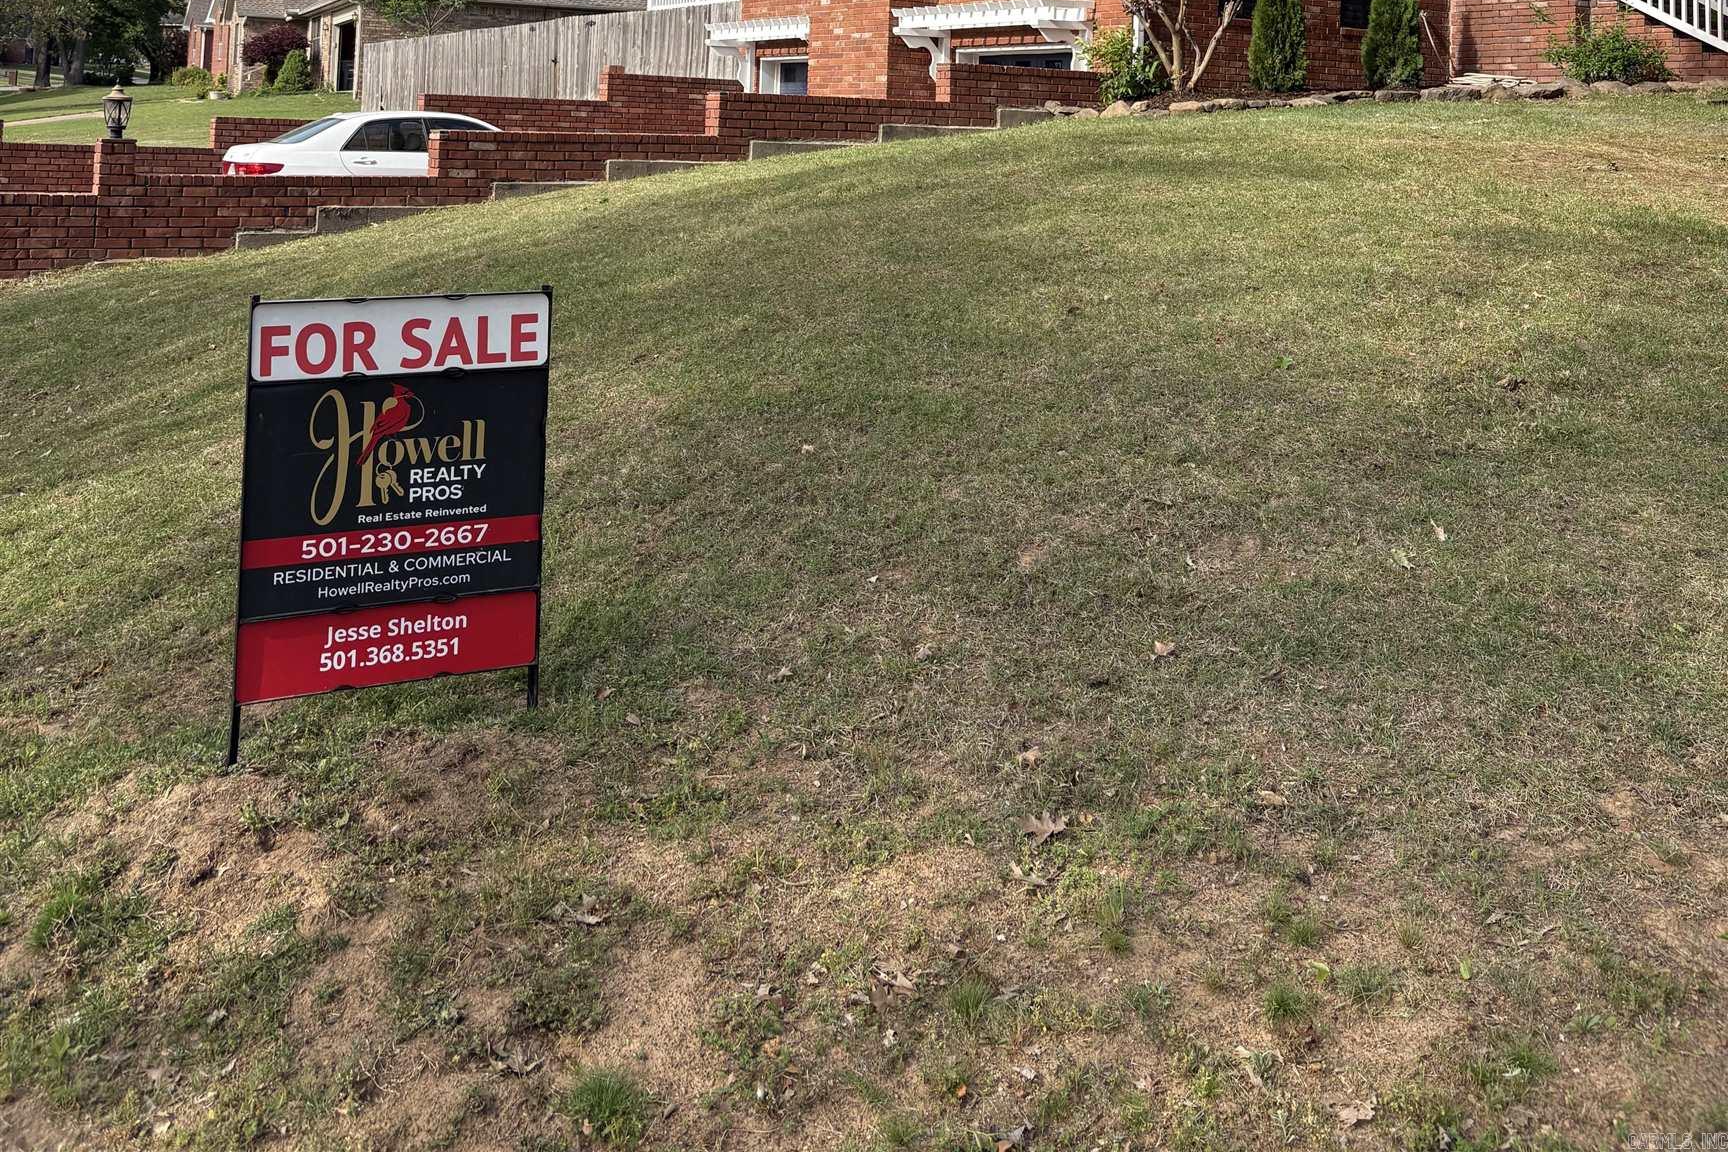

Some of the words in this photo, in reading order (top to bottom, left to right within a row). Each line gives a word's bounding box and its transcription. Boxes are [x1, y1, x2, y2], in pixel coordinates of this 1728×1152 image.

[259, 322, 379, 377] FOR
[400, 313, 539, 369] SALE
[309, 389, 487, 526] Howell
[409, 464, 487, 484] REALTY
[409, 484, 463, 503] PROS
[357, 512, 383, 524] Real
[385, 509, 423, 522] Estate
[425, 504, 487, 517] Reinvented
[301, 523, 489, 560] 501-230-2667
[273, 562, 384, 586] RESIDENTIAL
[388, 560, 400, 574] &
[404, 549, 512, 572] COMMERCIAL
[318, 573, 471, 599] HowellRealtyPros.com
[324, 623, 382, 649] Jesse
[387, 612, 468, 637] Shelton
[319, 637, 461, 672] 501.368.5351
